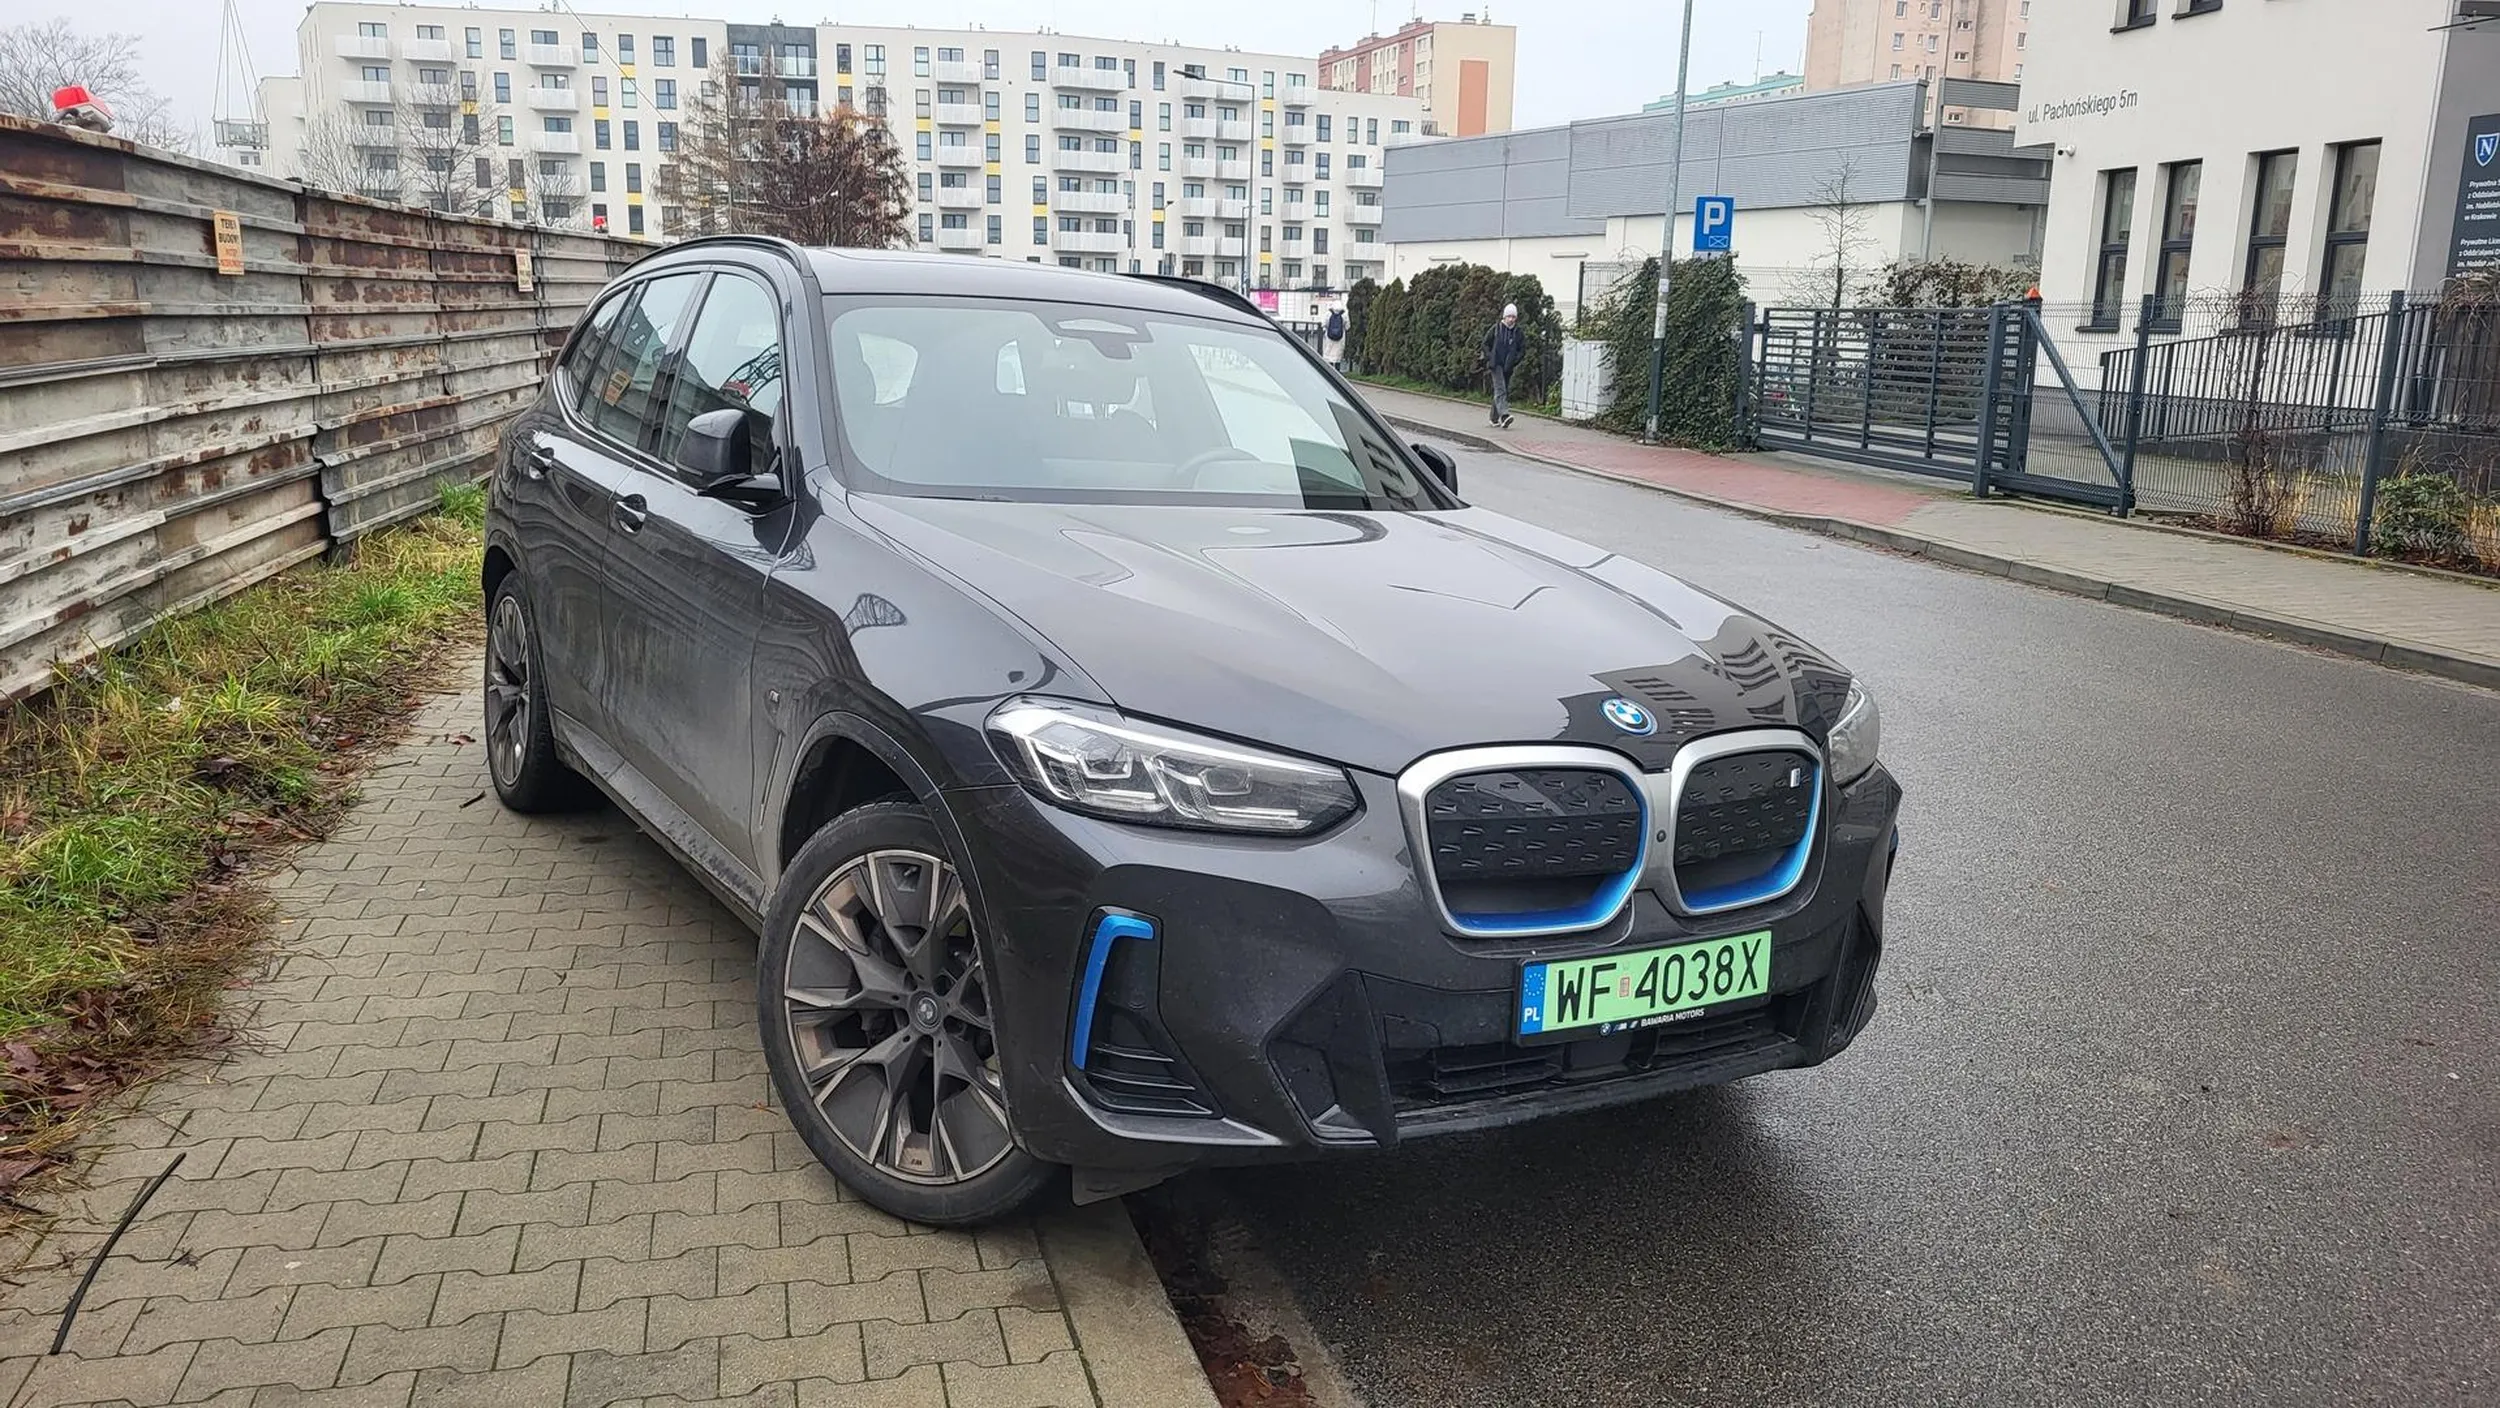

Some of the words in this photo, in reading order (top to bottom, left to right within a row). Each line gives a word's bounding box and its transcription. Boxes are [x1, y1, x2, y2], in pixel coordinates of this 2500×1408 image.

[2028, 104, 2039, 123] ul.
[2043, 96, 2116, 121] Pachońskiego
[2119, 89, 2138, 109] 5m
[1703, 201, 1726, 235] P
[1557, 962, 1617, 1023] WF
[1634, 938, 1762, 1010] 4038X
[1523, 1007, 1540, 1022] PL
[1640, 1013, 1674, 1027] BAWARIA
[1675, 1008, 1705, 1021] MOTORS
